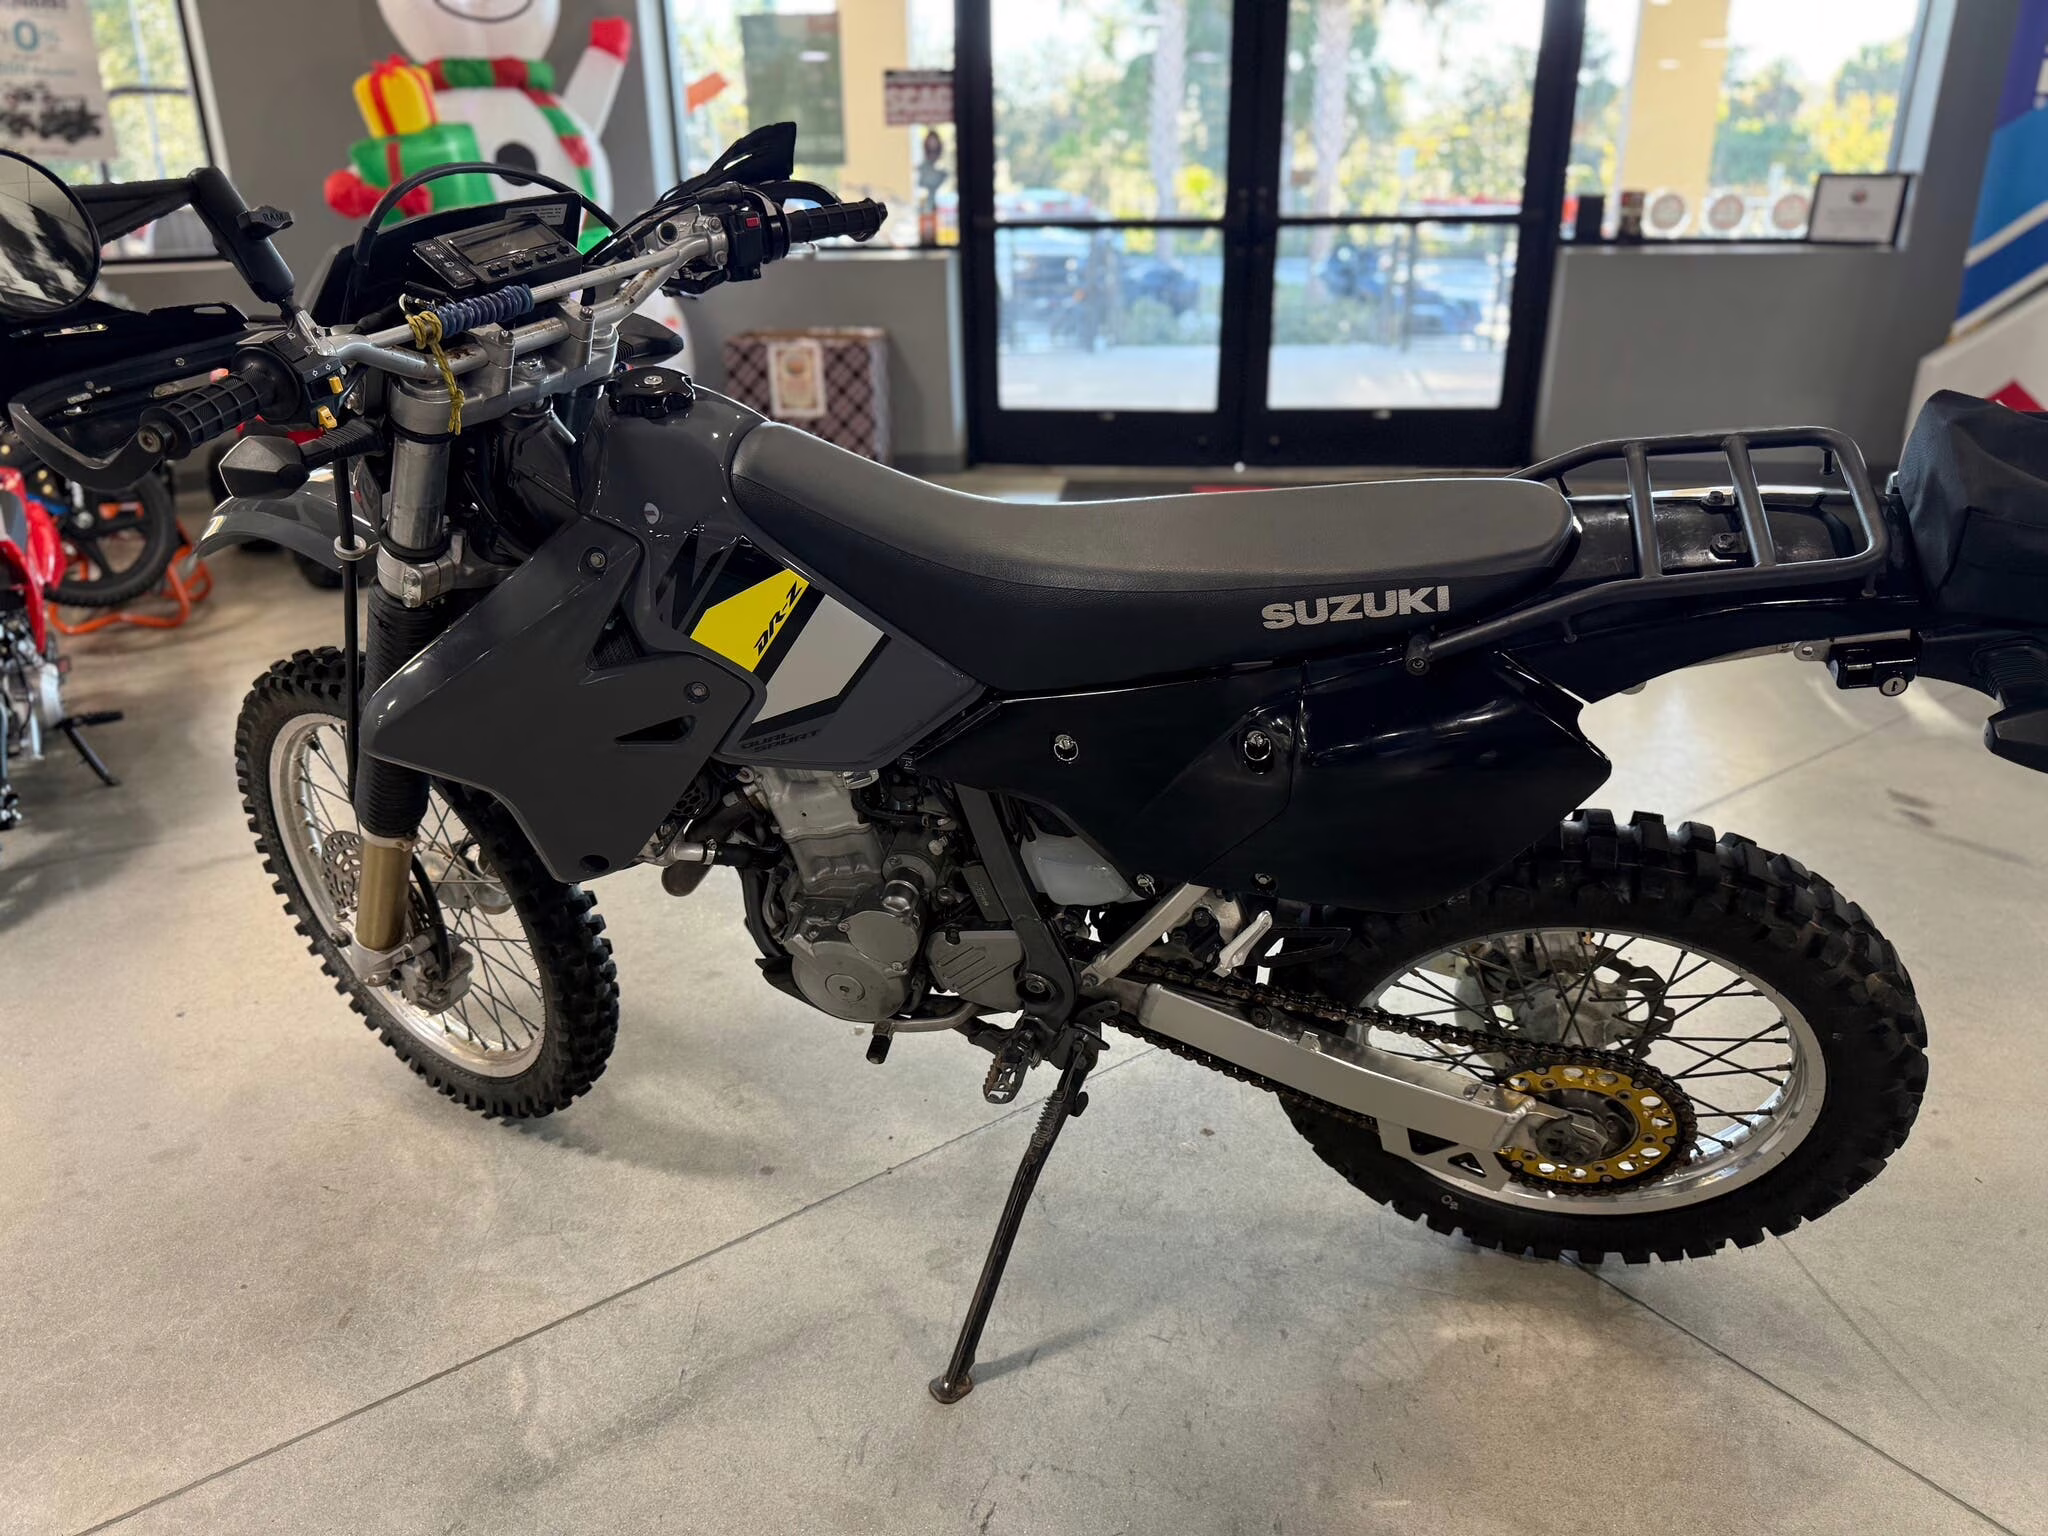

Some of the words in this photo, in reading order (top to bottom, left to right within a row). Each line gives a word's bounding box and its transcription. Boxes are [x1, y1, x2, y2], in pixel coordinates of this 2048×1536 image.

[753, 580, 803, 656] DR-Z
[1261, 585, 1451, 630] SUZUKI
[741, 732, 790, 749] DUAL
[753, 728, 821, 753] SPORT
